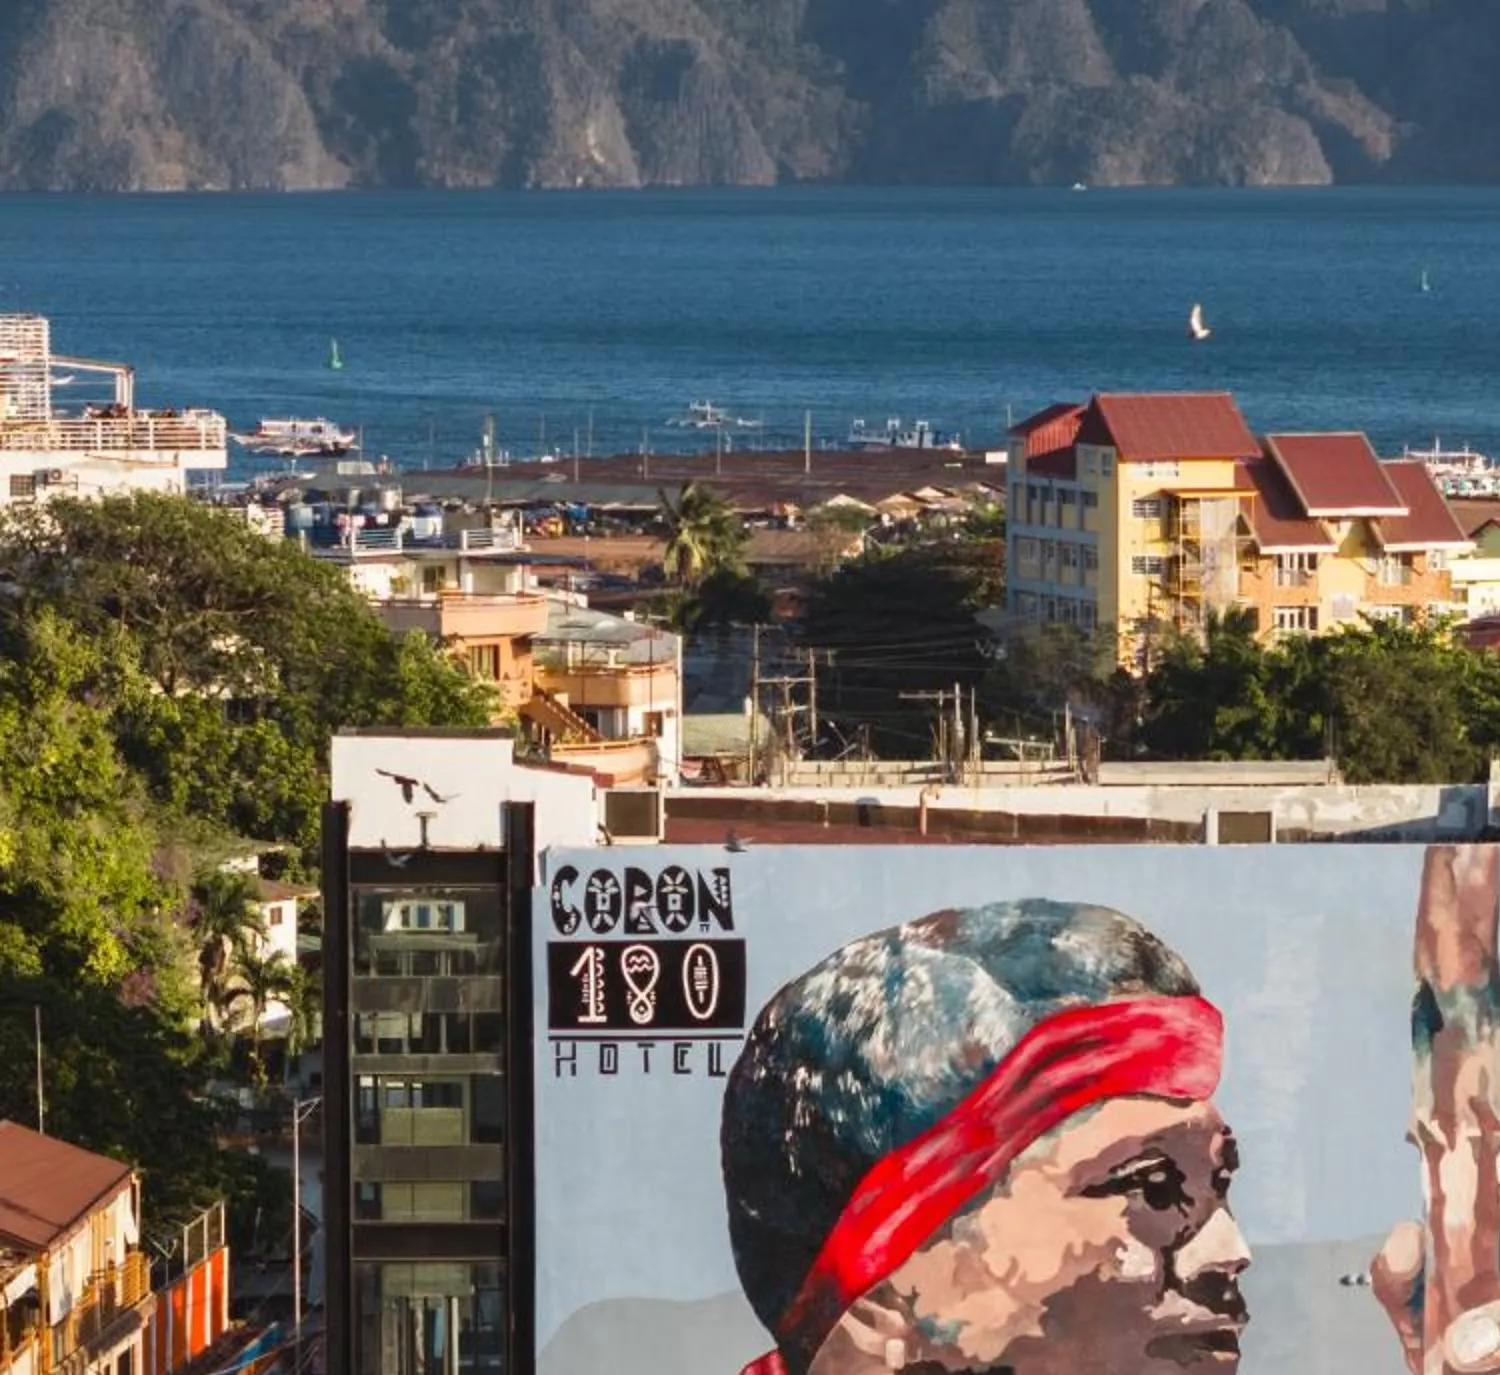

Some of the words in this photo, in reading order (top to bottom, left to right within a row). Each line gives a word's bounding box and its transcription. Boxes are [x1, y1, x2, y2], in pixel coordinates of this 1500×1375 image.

[551, 865, 735, 936] CORON
[570, 944, 720, 1024] 180
[555, 1042, 727, 1078] HOTEL
